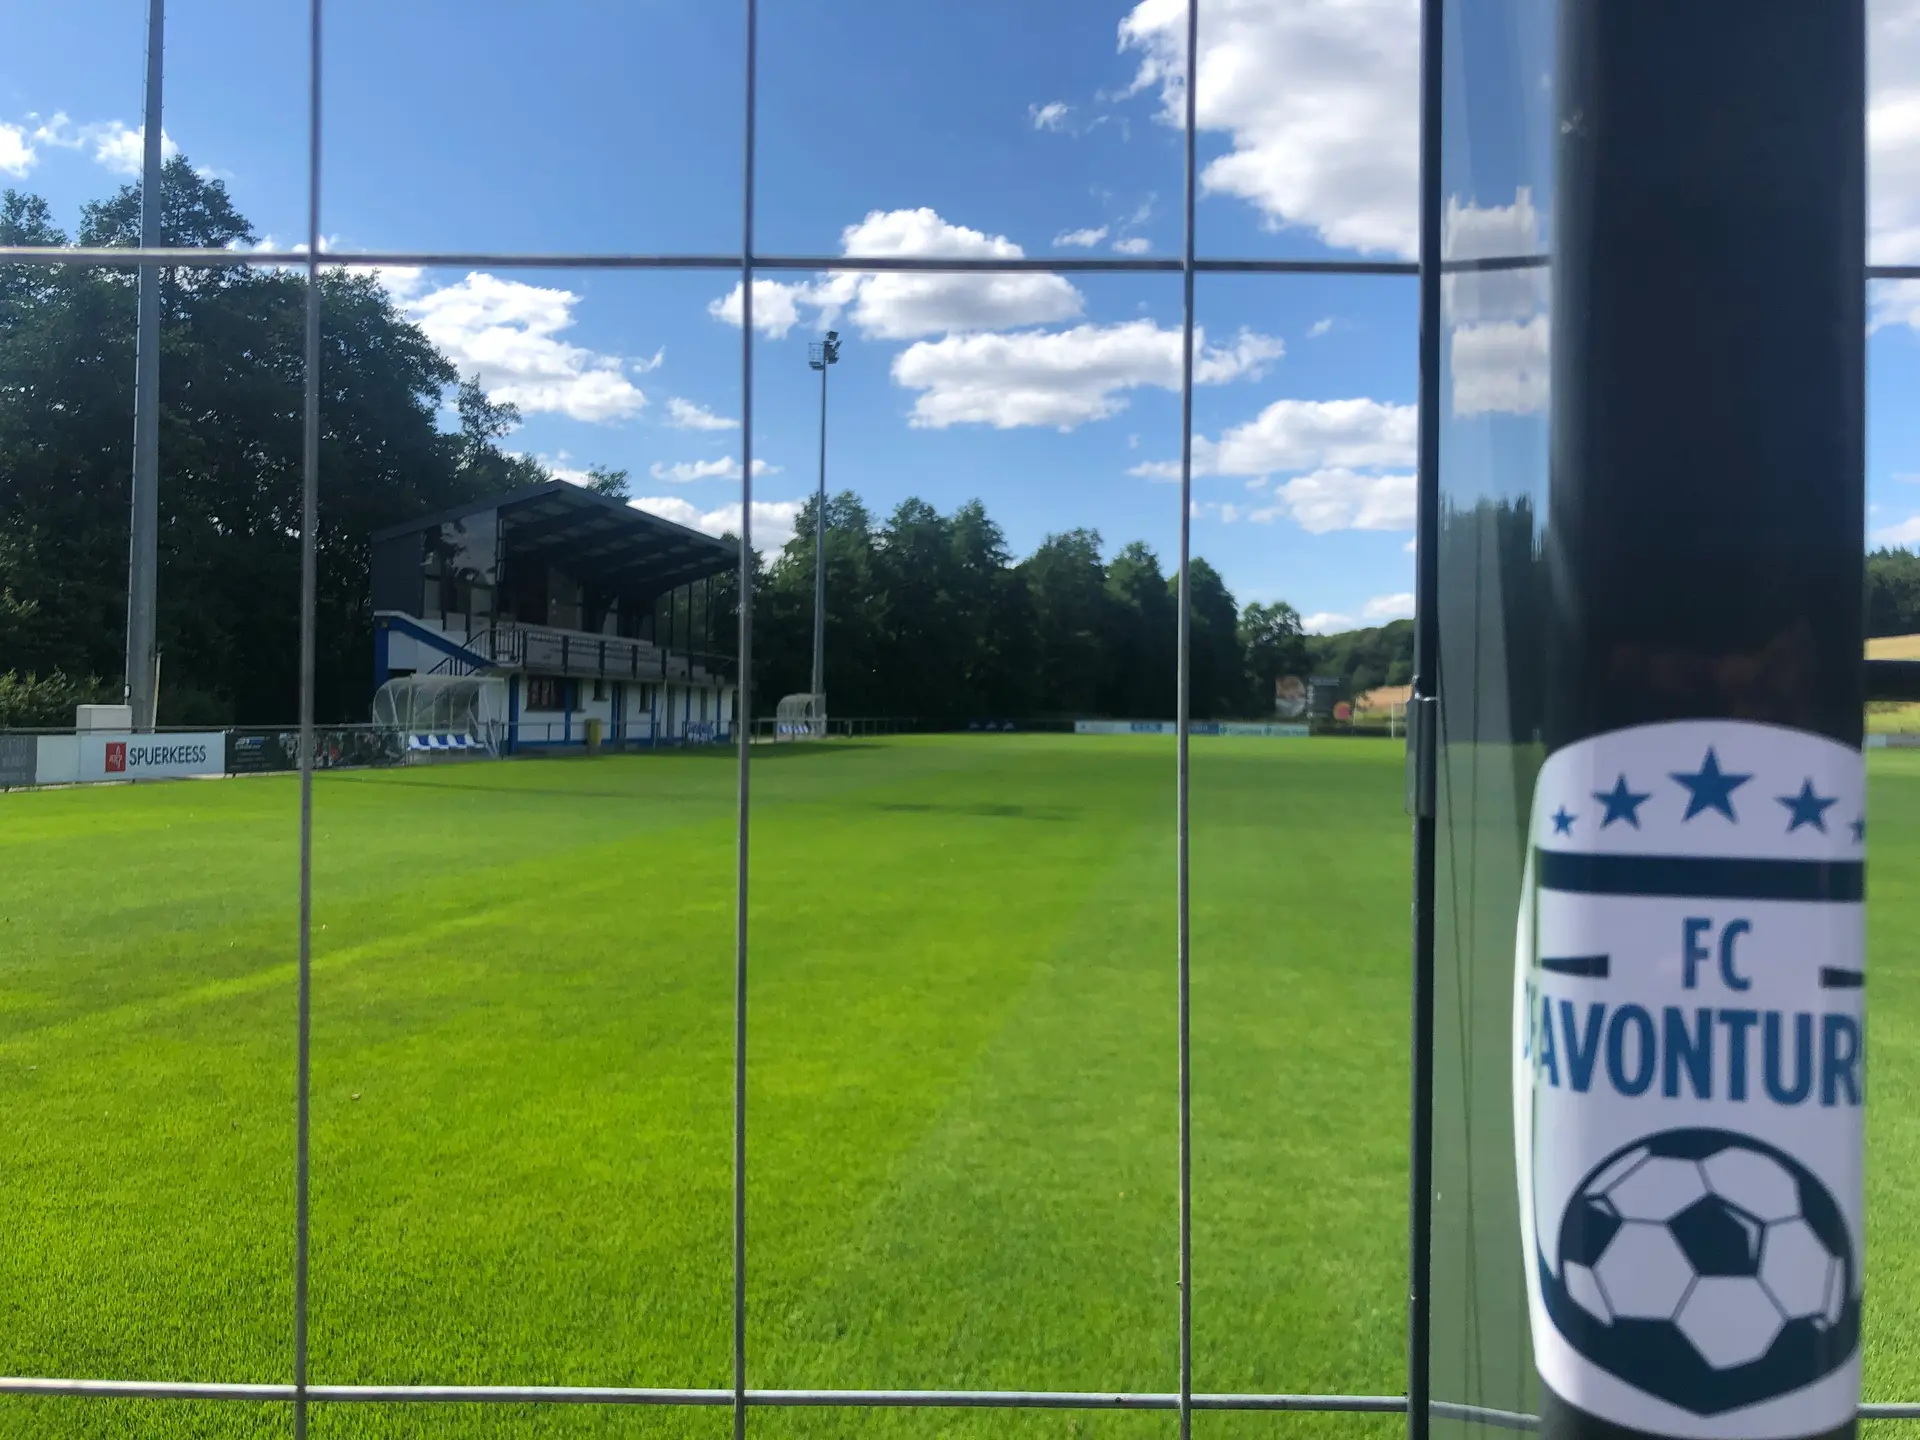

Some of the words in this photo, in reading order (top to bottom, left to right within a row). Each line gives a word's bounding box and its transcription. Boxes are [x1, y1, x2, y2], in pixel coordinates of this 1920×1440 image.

[129, 745, 207, 766] SPUERKEESS
[1682, 916, 1752, 991] FC
[1525, 984, 1864, 1108] AVONTUR
